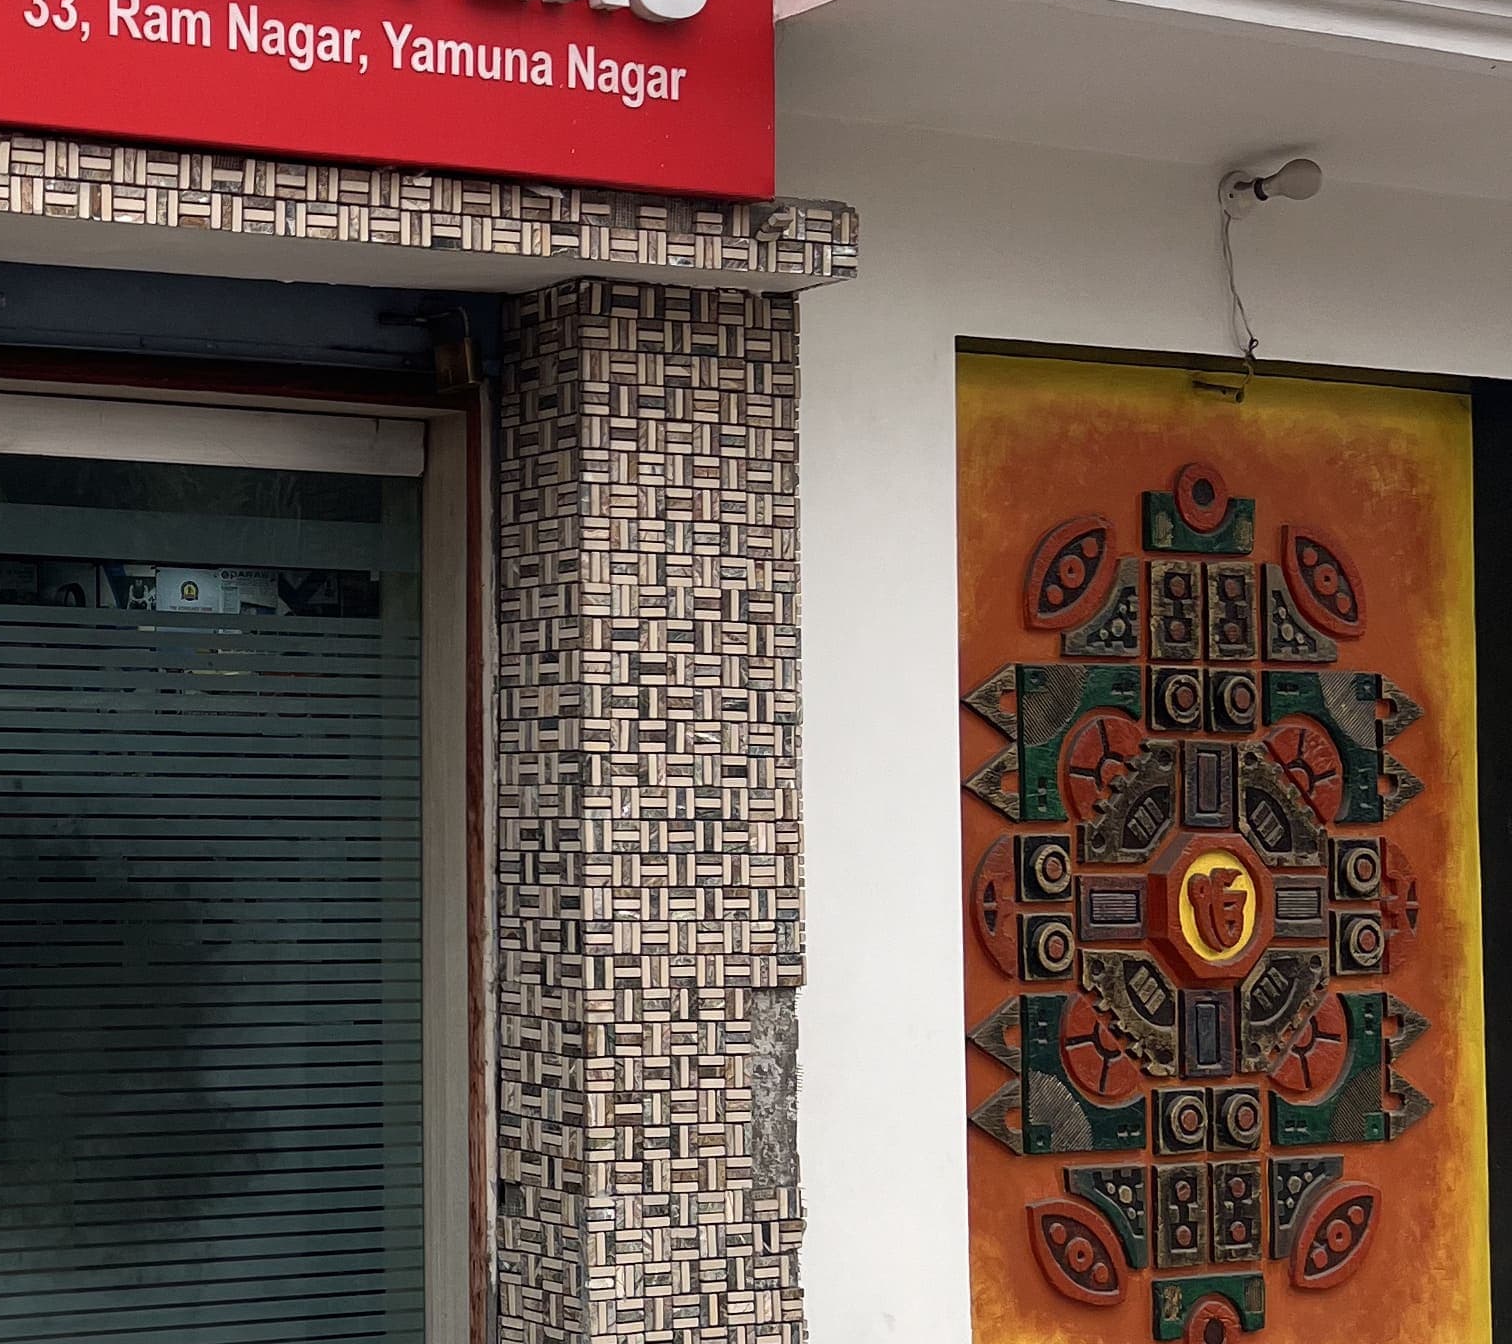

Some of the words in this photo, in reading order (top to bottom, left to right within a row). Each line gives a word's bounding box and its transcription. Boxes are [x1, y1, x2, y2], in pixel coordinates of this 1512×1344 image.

[227, 1, 370, 74] Nagar,
[381, 20, 554, 87] Yamuna
[567, 42, 687, 108] Nagar
